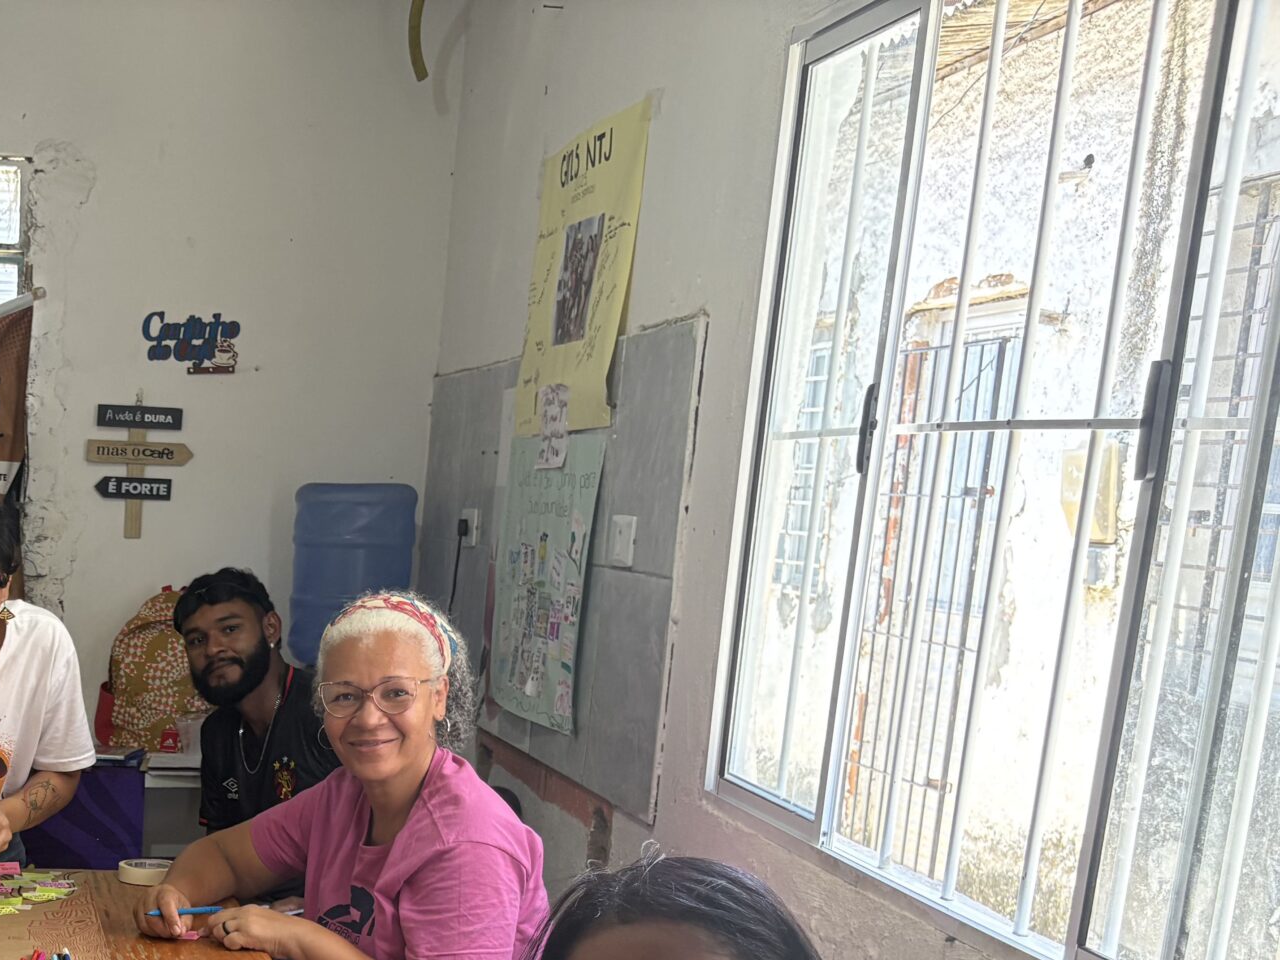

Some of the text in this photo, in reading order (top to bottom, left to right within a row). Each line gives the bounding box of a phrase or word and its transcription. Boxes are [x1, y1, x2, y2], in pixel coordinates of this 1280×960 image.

[106, 409, 114, 421] A
[135, 411, 142, 422] é
[144, 414, 173, 424] DURA
[96, 445, 128, 457] mas
[131, 448, 140, 459] o
[108, 478, 168, 496] É FORTE
